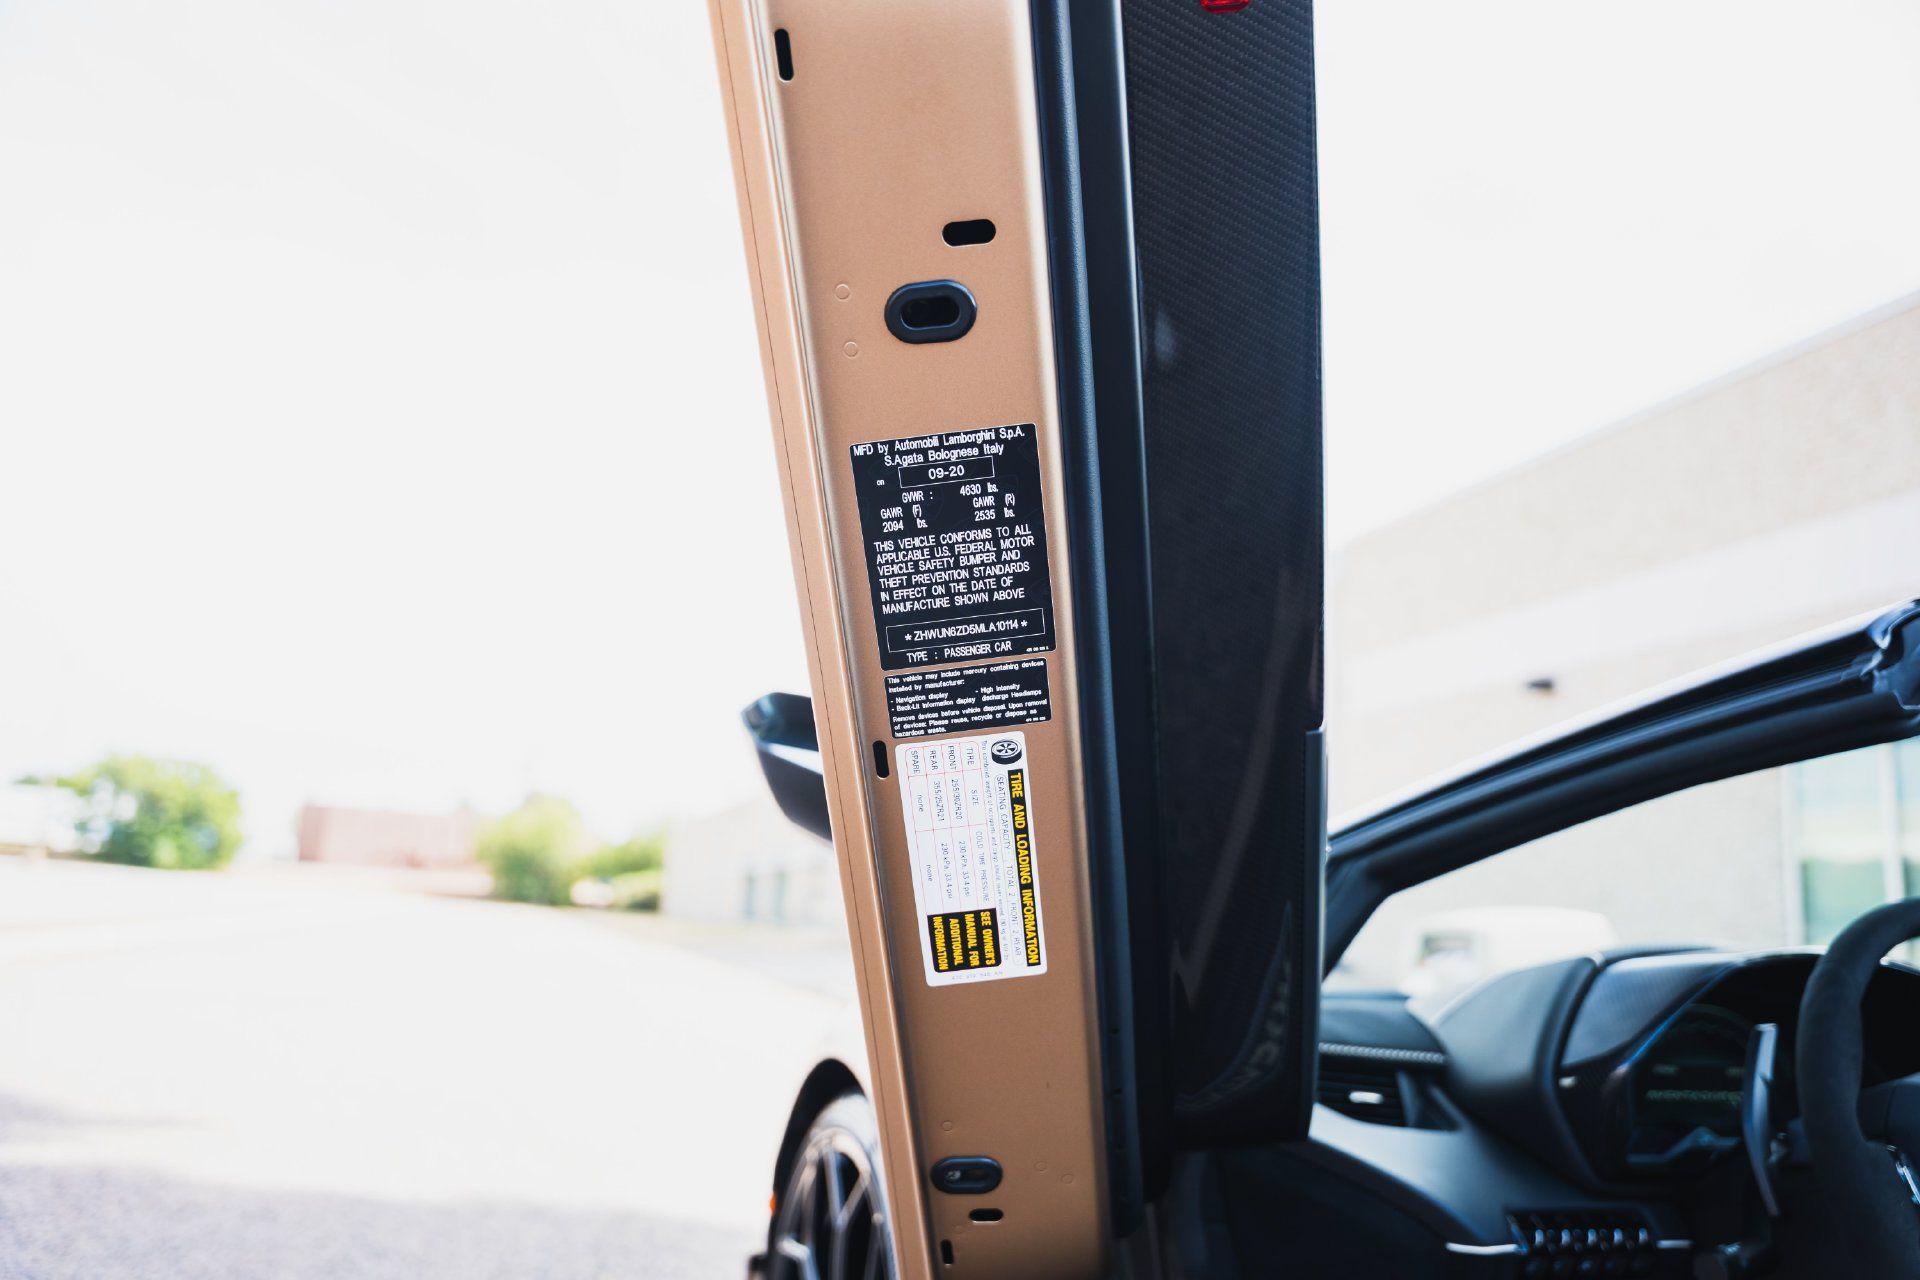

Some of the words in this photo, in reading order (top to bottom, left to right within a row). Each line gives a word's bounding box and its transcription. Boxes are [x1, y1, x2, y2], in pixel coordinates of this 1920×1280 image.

[852, 444, 873, 456] MFD
[877, 442, 889, 455] by
[893, 436, 939, 451] Automobili
[942, 429, 995, 447] Lamborghini
[999, 426, 1025, 440] S.p.A.
[883, 451, 923, 468] S.Agata
[928, 444, 978, 462] Bolognese
[983, 442, 1004, 456] Italy
[876, 478, 884, 486] on
[927, 464, 964, 479] 09-20
[901, 491, 924, 503] GVWR
[959, 483, 981, 496] 4630
[972, 495, 994, 507] GAWR
[1004, 493, 1015, 506] (R)
[880, 507, 903, 519] GAWR
[911, 504, 922, 517] (F)
[974, 509, 995, 521] 2535
[873, 540, 894, 552] THIS
[898, 535, 935, 549] VEHICLE
[939, 528, 992, 544] CONFORMS
[996, 526, 1009, 537] TO
[1013, 523, 1031, 535] ALL
[882, 520, 904, 532] 2094
[875, 548, 930, 564] APPLICABLE
[934, 545, 951, 557] U.S.
[954, 540, 996, 554] FEDERAL
[1000, 536, 1034, 549] MOTOR
[877, 562, 914, 576] VEHICLE
[918, 557, 955, 571] SAFETY
[959, 552, 996, 566] BUMPER
[1000, 549, 1020, 561] AND
[878, 575, 908, 588] THEFT
[911, 568, 969, 585] PREVENTION
[972, 561, 1030, 577] STANDARDS
[880, 591, 889, 601] IN
[893, 586, 928, 600] EFFECT
[931, 584, 945, 595] ON
[949, 581, 967, 593] THE
[971, 578, 996, 590] DATE
[1000, 576, 1013, 587] OF
[882, 596, 950, 614] MANUFACTURE
[954, 592, 988, 605] SHOWN
[992, 588, 1024, 601] ABOVE
[906, 651, 928, 662] TYPE
[944, 643, 991, 658] PASSENGER
[994, 640, 1012, 652] CAR
[902, 674, 922, 682] vehicle
[924, 673, 937, 681] may
[963, 667, 987, 676] mercury
[989, 663, 1018, 673] containing
[1021, 660, 1044, 668] devices
[895, 694, 926, 704] Navigation
[928, 691, 948, 700] display
[914, 683, 922, 691] by
[980, 686, 993, 694] High
[892, 714, 915, 722] Remove
[917, 711, 938, 719] devices
[940, 709, 959, 717] before
[961, 706, 980, 714] vehicle
[1008, 702, 1022, 710] Upon
[1024, 699, 1047, 707] removal
[955, 696, 976, 705] display
[928, 718, 948, 726] Please
[971, 713, 993, 722] recycle
[894, 728, 924, 737] hazardous
[910, 750, 920, 773] SPARE
[929, 750, 938, 770] REAR
[947, 745, 956, 770] FRONT
[966, 747, 974, 765] TIRE
[996, 776, 1006, 809] SEATING
[1009, 772, 1022, 798] TIRE
[916, 794, 925, 812] none
[1012, 803, 1025, 828] AND
[1000, 813, 1010, 849] CAPACITY
[975, 830, 983, 848] COLD
[980, 869, 989, 902] PRESSURE
[1015, 833, 1030, 884] LOADING
[925, 864, 933, 881] none
[1005, 865, 1014, 887] TOTAL
[980, 911, 991, 926] SEE
[1009, 902, 1018, 926] FRONT
[964, 913, 977, 948] MANUAL
[1021, 889, 1038, 963] INFORMATION
[932, 916, 948, 970] INFORMATION
[948, 918, 963, 965] ADDITIONAL
[982, 928, 995, 965] OWNER'S
[1013, 937, 1021, 956] REAR
[968, 950, 979, 966] FOR
